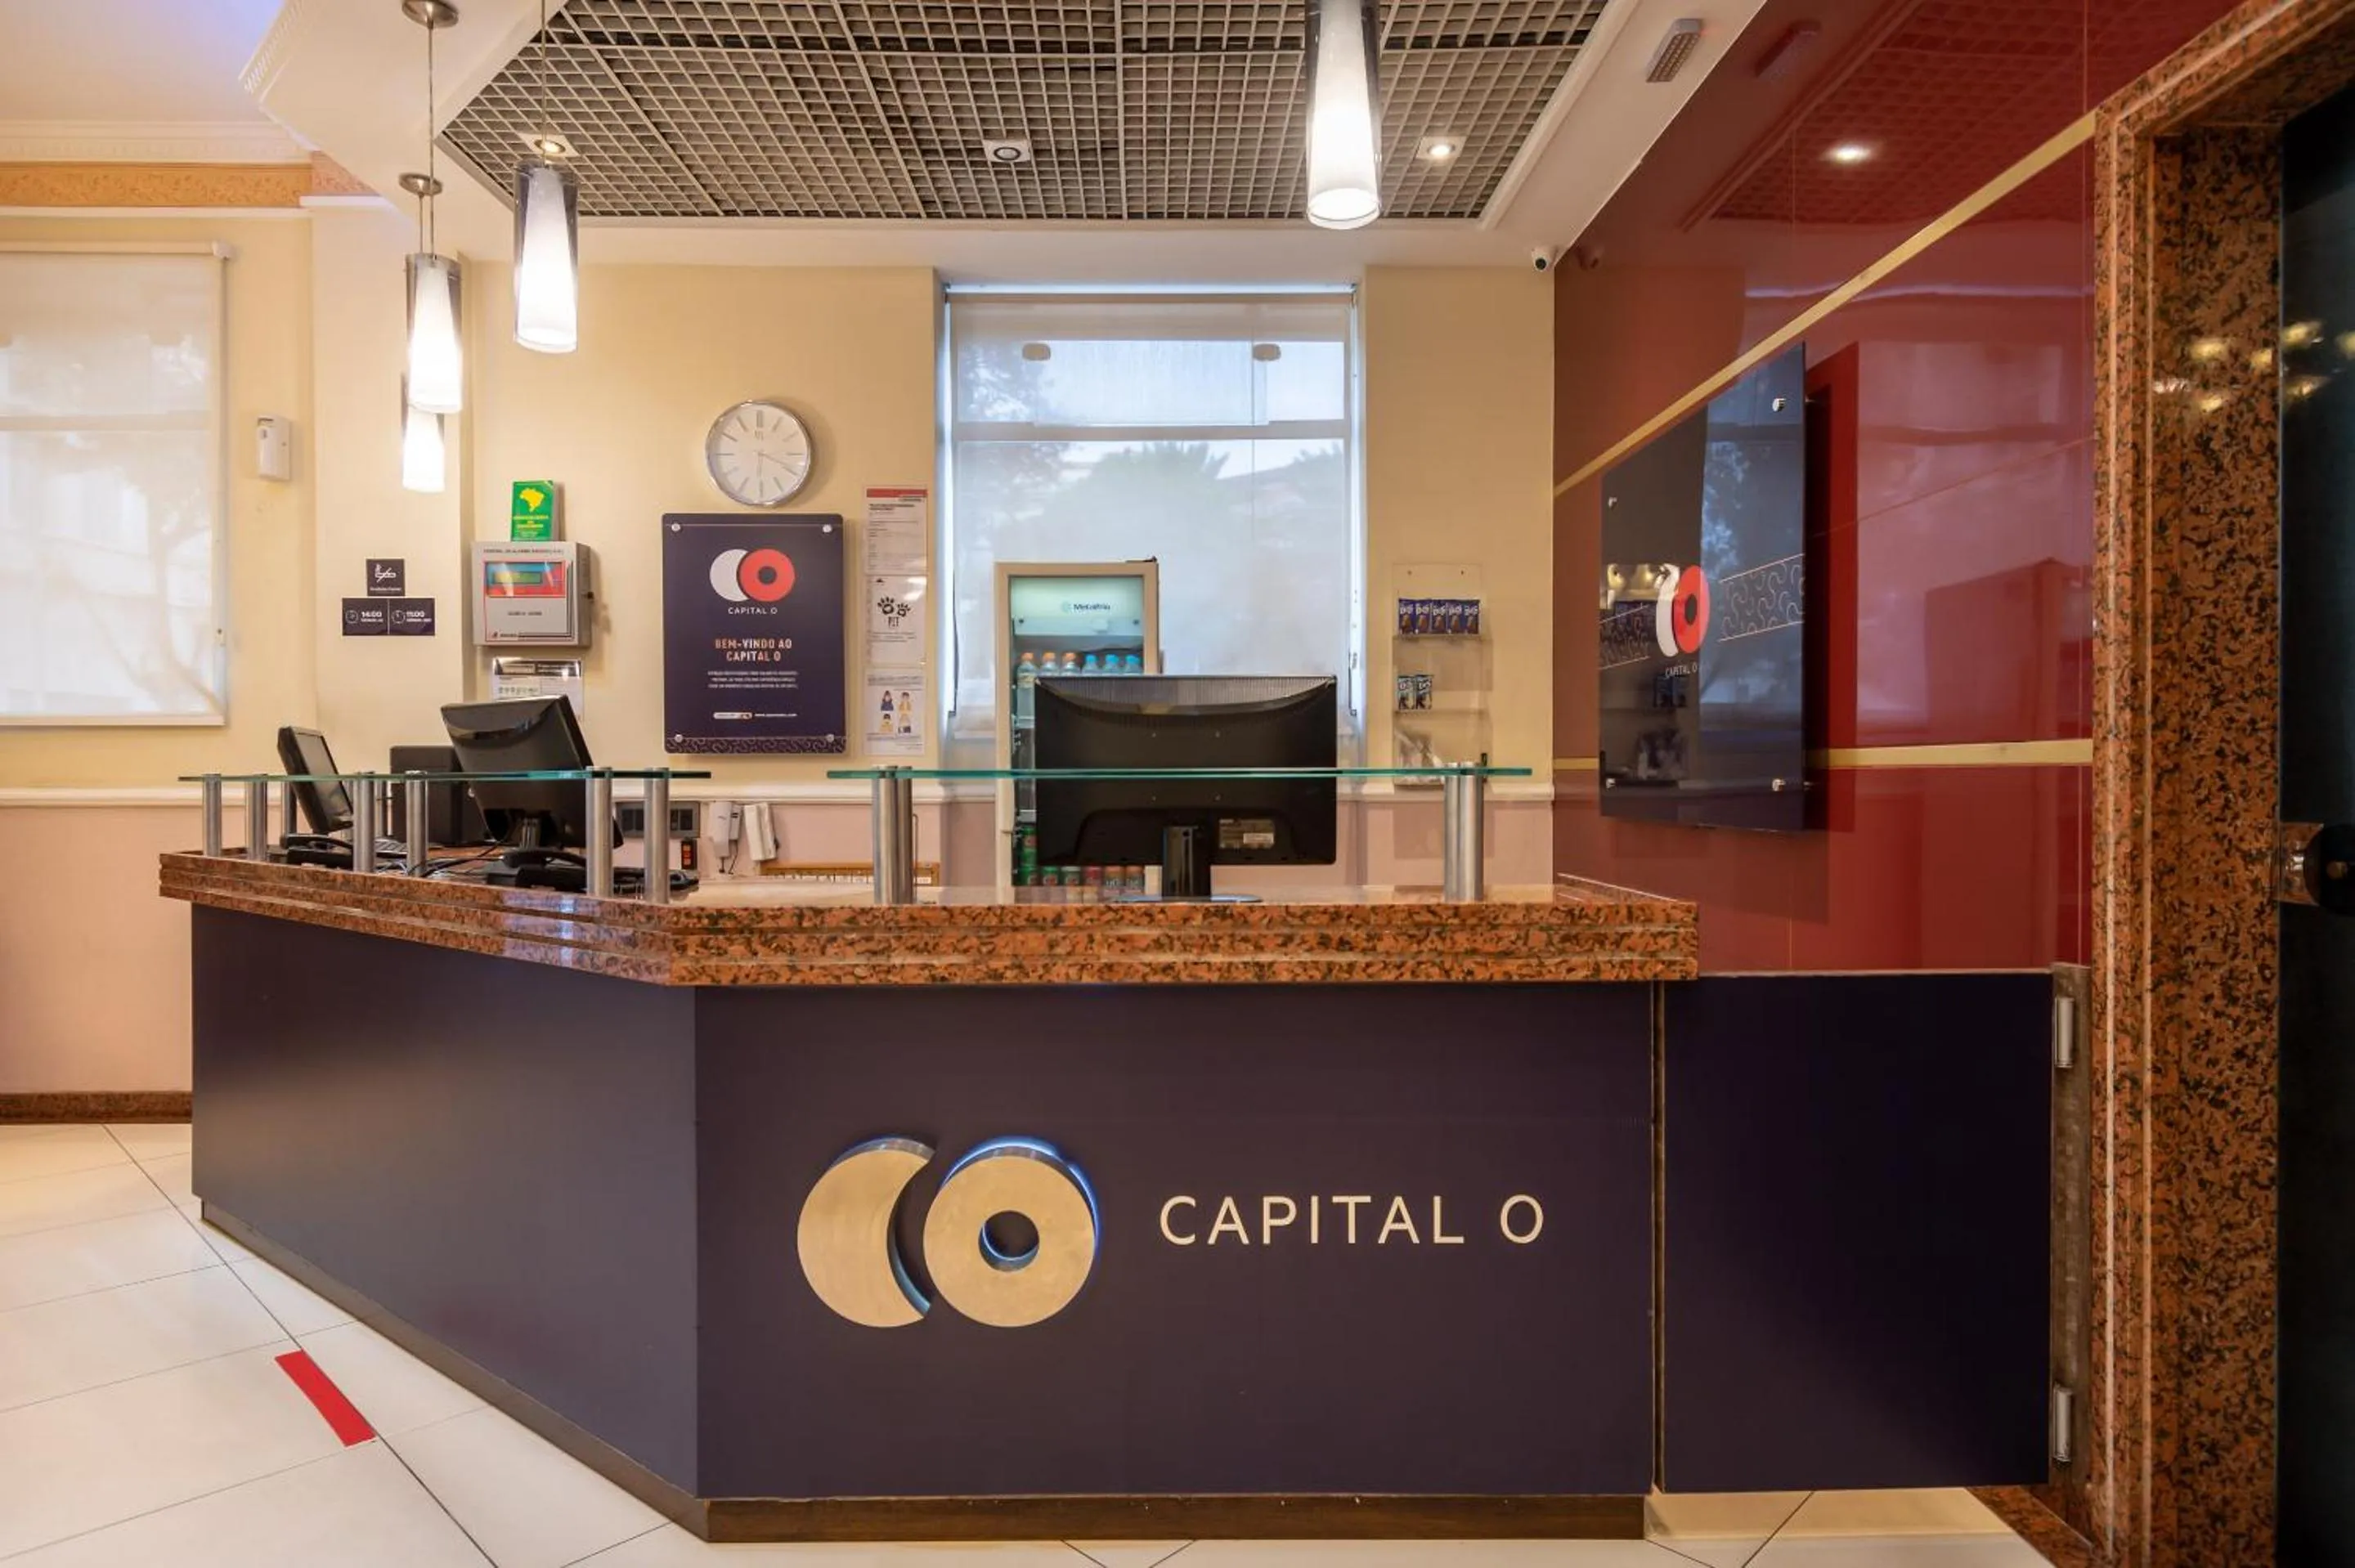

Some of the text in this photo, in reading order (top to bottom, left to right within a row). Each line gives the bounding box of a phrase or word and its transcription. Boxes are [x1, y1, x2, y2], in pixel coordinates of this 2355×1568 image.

[728, 607, 778, 615] CAPITAL O
[715, 638, 792, 649] BEM-VINDO AO
[726, 651, 782, 661] CAPITAL O
[1160, 1194, 1544, 1245] CAPITAL O
